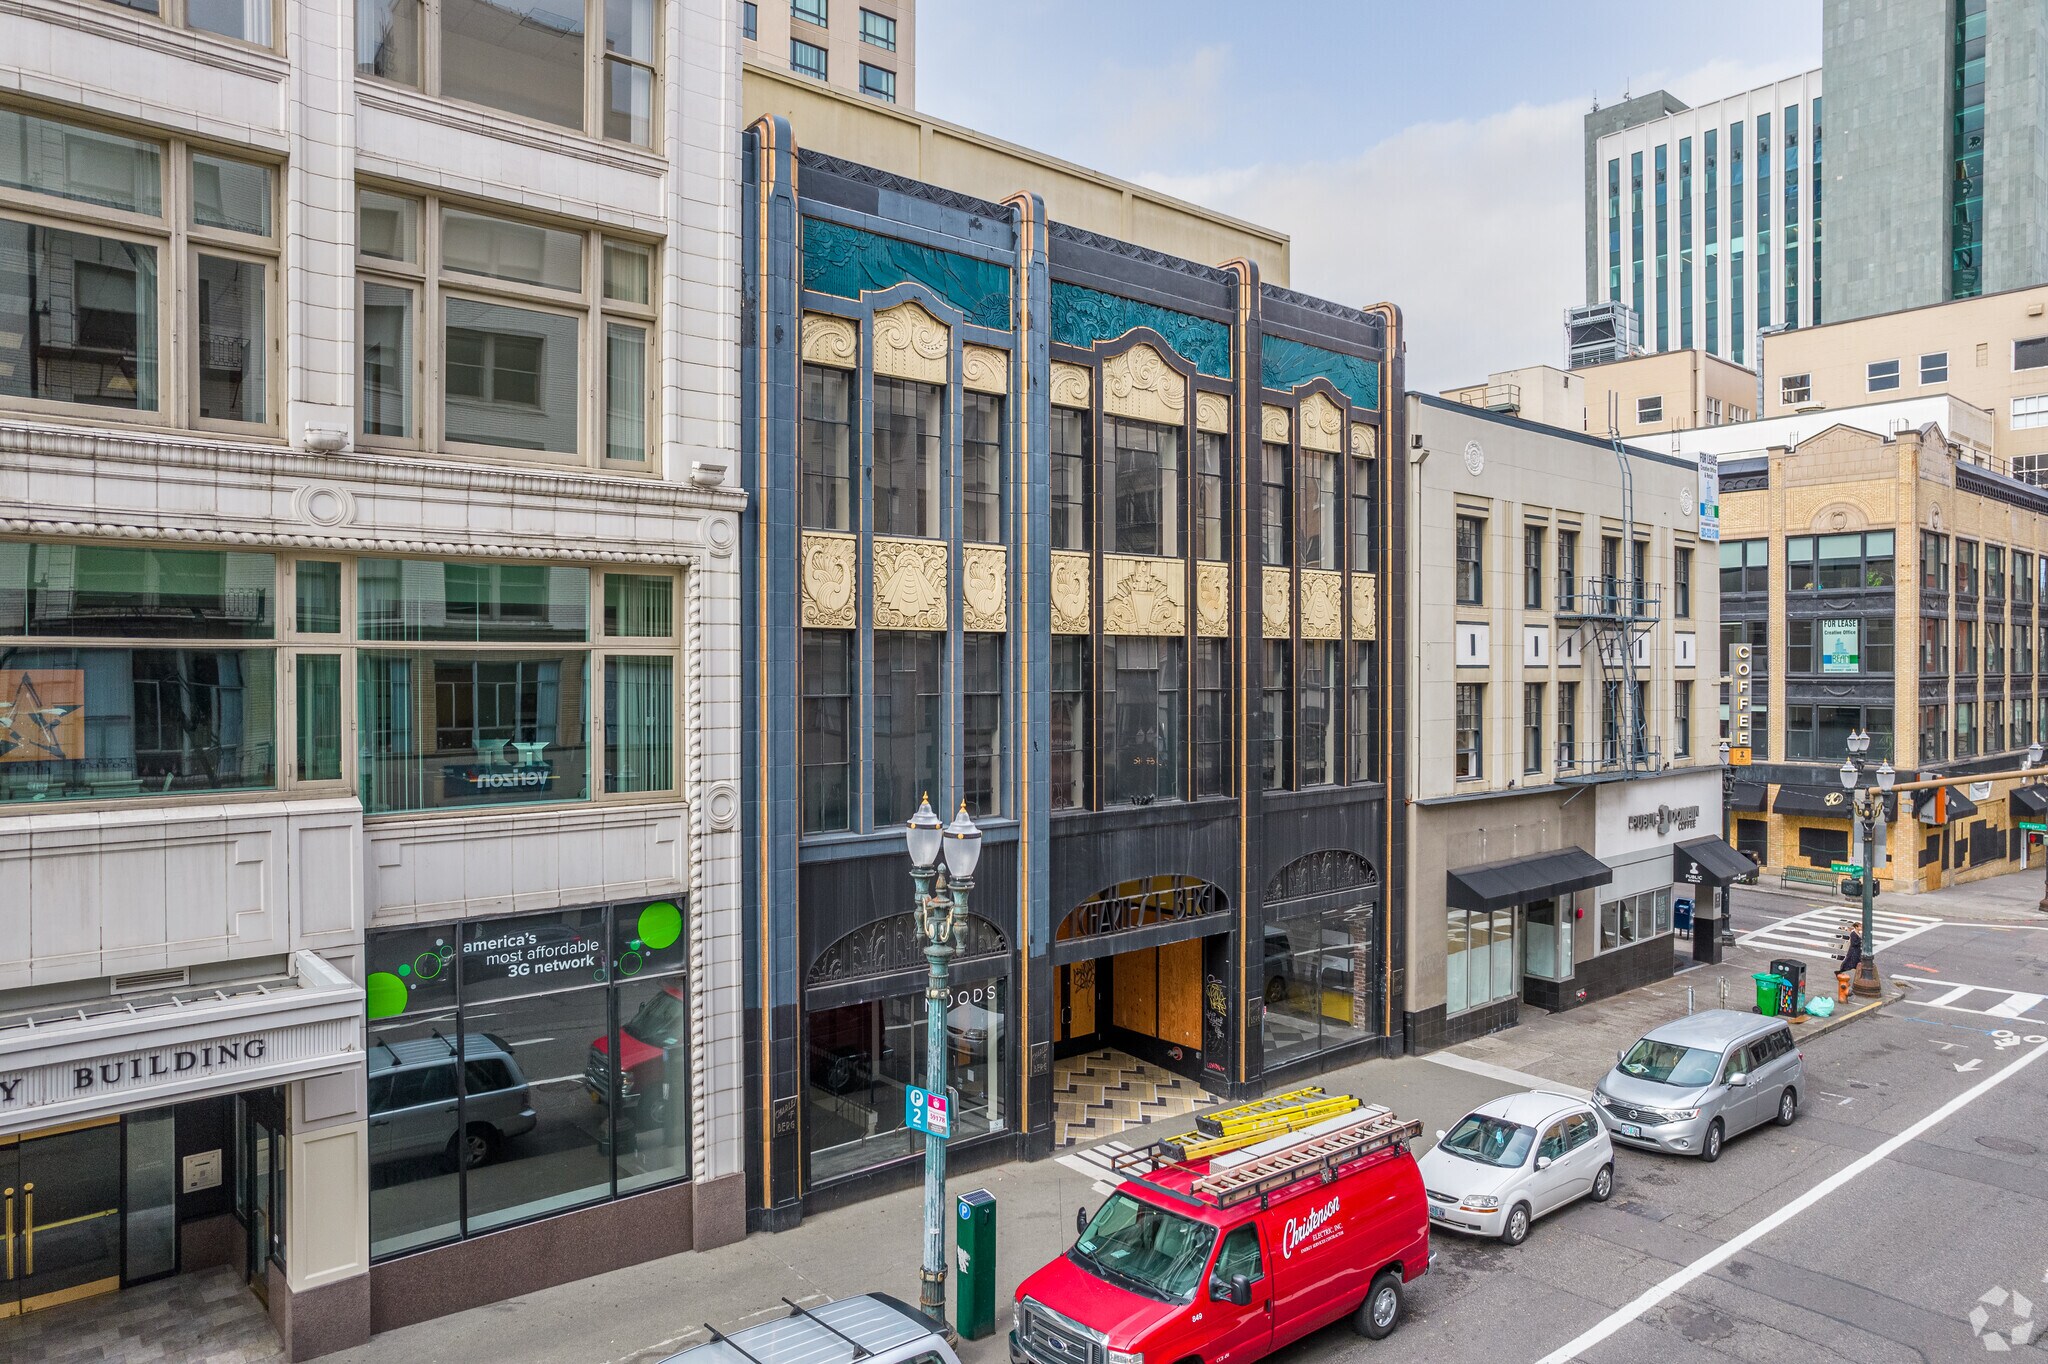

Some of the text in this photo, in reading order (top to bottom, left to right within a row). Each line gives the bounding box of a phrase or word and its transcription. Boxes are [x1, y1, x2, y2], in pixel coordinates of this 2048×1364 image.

[1707, 454, 1717, 466] LEASE
[1824, 619, 1856, 628] FOR LEASE
[1736, 645, 1750, 745] COFFEE
[1628, 805, 1699, 830] PUBLIC DOMAIN
[1677, 819, 1697, 831] COFFEE
[1685, 873, 1703, 881] PUBLIC
[463, 932, 537, 953] america's
[486, 939, 600, 966] most affordable
[508, 954, 595, 978] 3G network
[0, 1038, 266, 1101] Y BUILDING
[912, 1108, 922, 1125] 2
[1283, 1196, 1340, 1260] Christenson
[1191, 1312, 1203, 1323] 849
